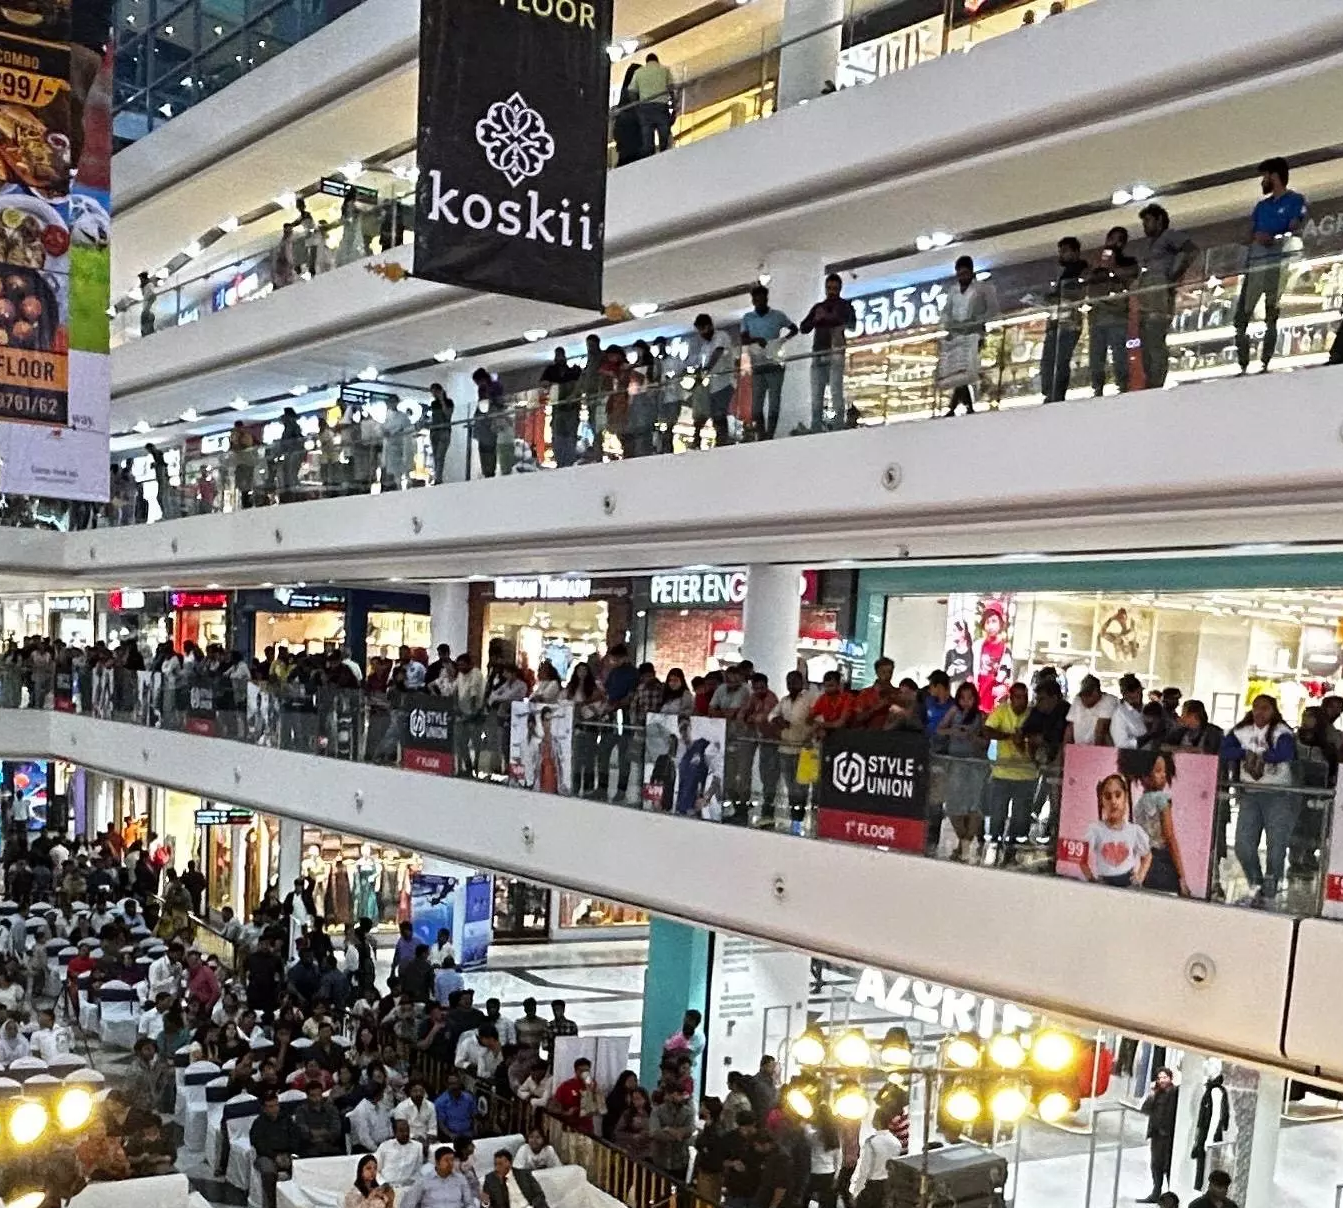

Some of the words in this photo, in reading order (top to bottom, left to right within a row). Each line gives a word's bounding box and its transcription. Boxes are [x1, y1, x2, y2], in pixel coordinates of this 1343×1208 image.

[499, 0, 595, 30] LOOR
[428, 170, 593, 250] koskii
[651, 574, 700, 604] PETER
[707, 573, 748, 604] ENG
[868, 755, 915, 777] STYLE
[866, 776, 913, 798] UNION
[857, 822, 896, 840] FLOOR
